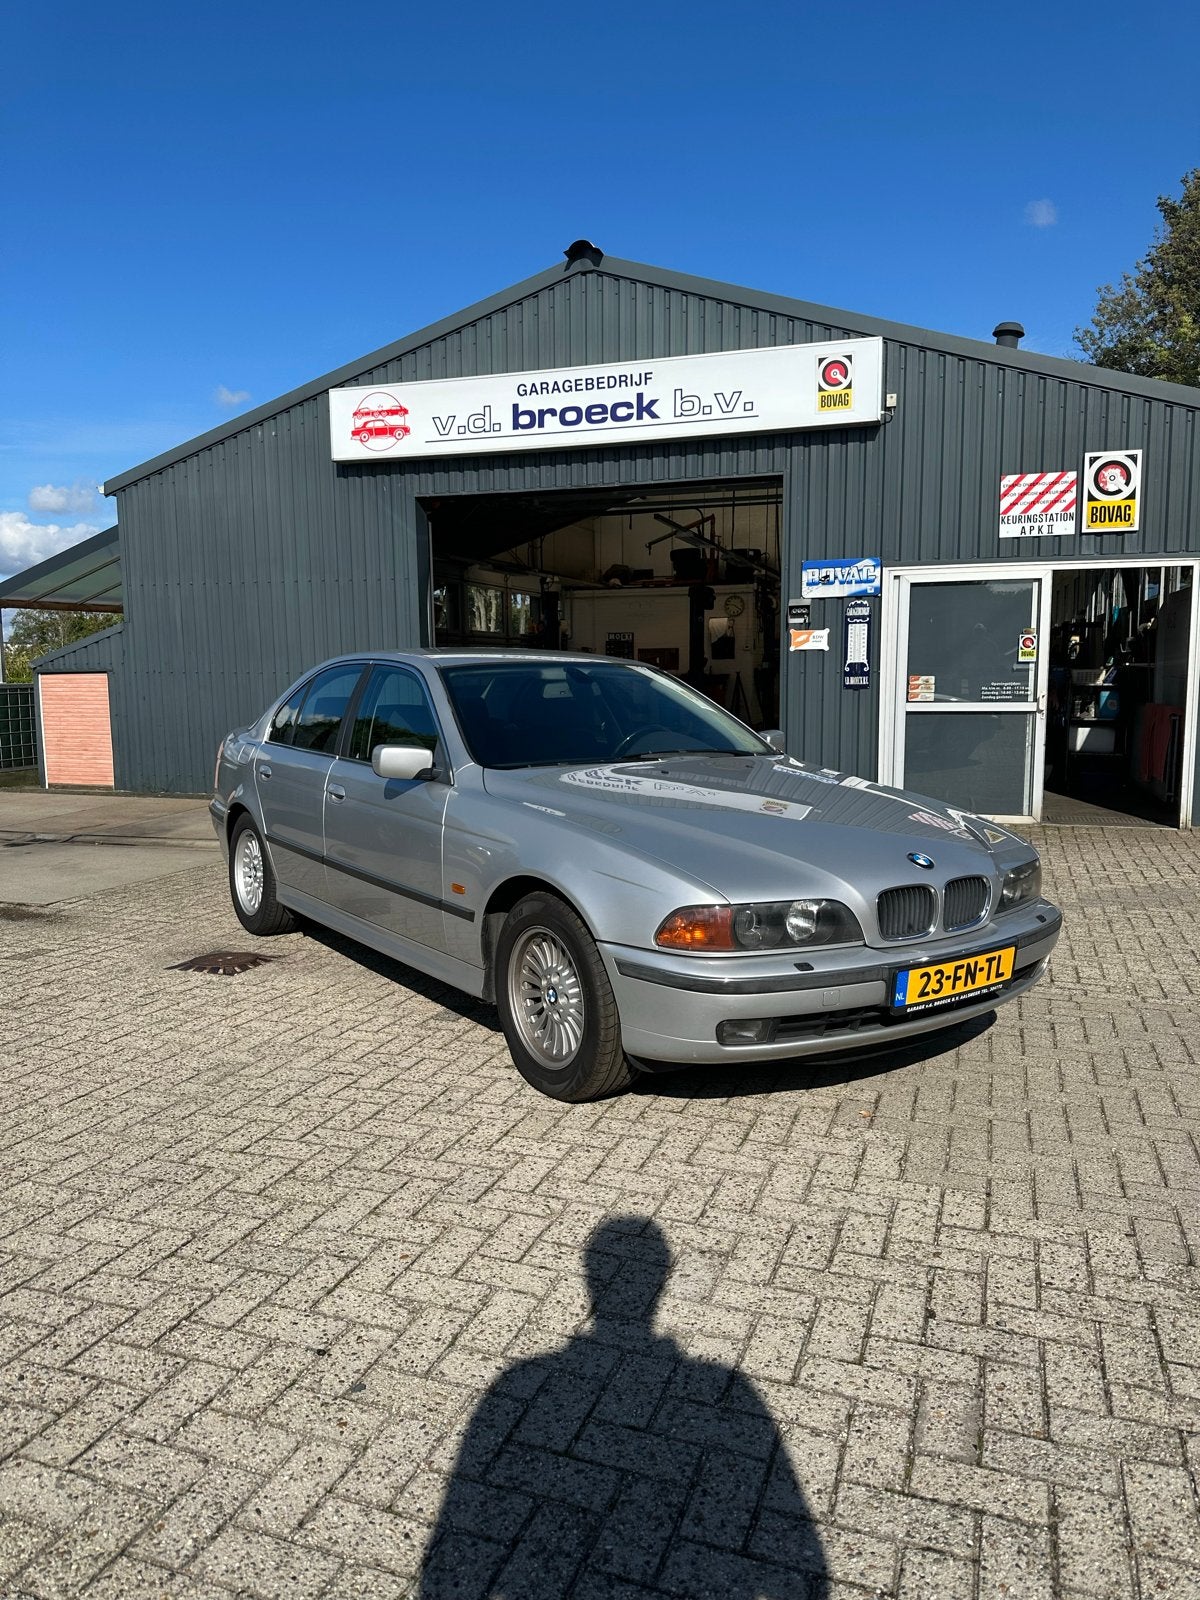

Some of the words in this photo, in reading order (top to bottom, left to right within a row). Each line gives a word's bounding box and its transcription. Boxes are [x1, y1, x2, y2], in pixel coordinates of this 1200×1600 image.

[516, 371, 653, 397] GARAGEBEDRIJF
[820, 392, 850, 408] BOVAG
[432, 405, 502, 436] v.d.
[512, 392, 660, 431] broeck
[674, 388, 754, 418] b.v.
[1000, 511, 1075, 525] KEURINGSTATION
[1090, 504, 1132, 524] BOVAG
[917, 954, 1005, 999] 23-FN-TL
[895, 992, 905, 1001] NL
